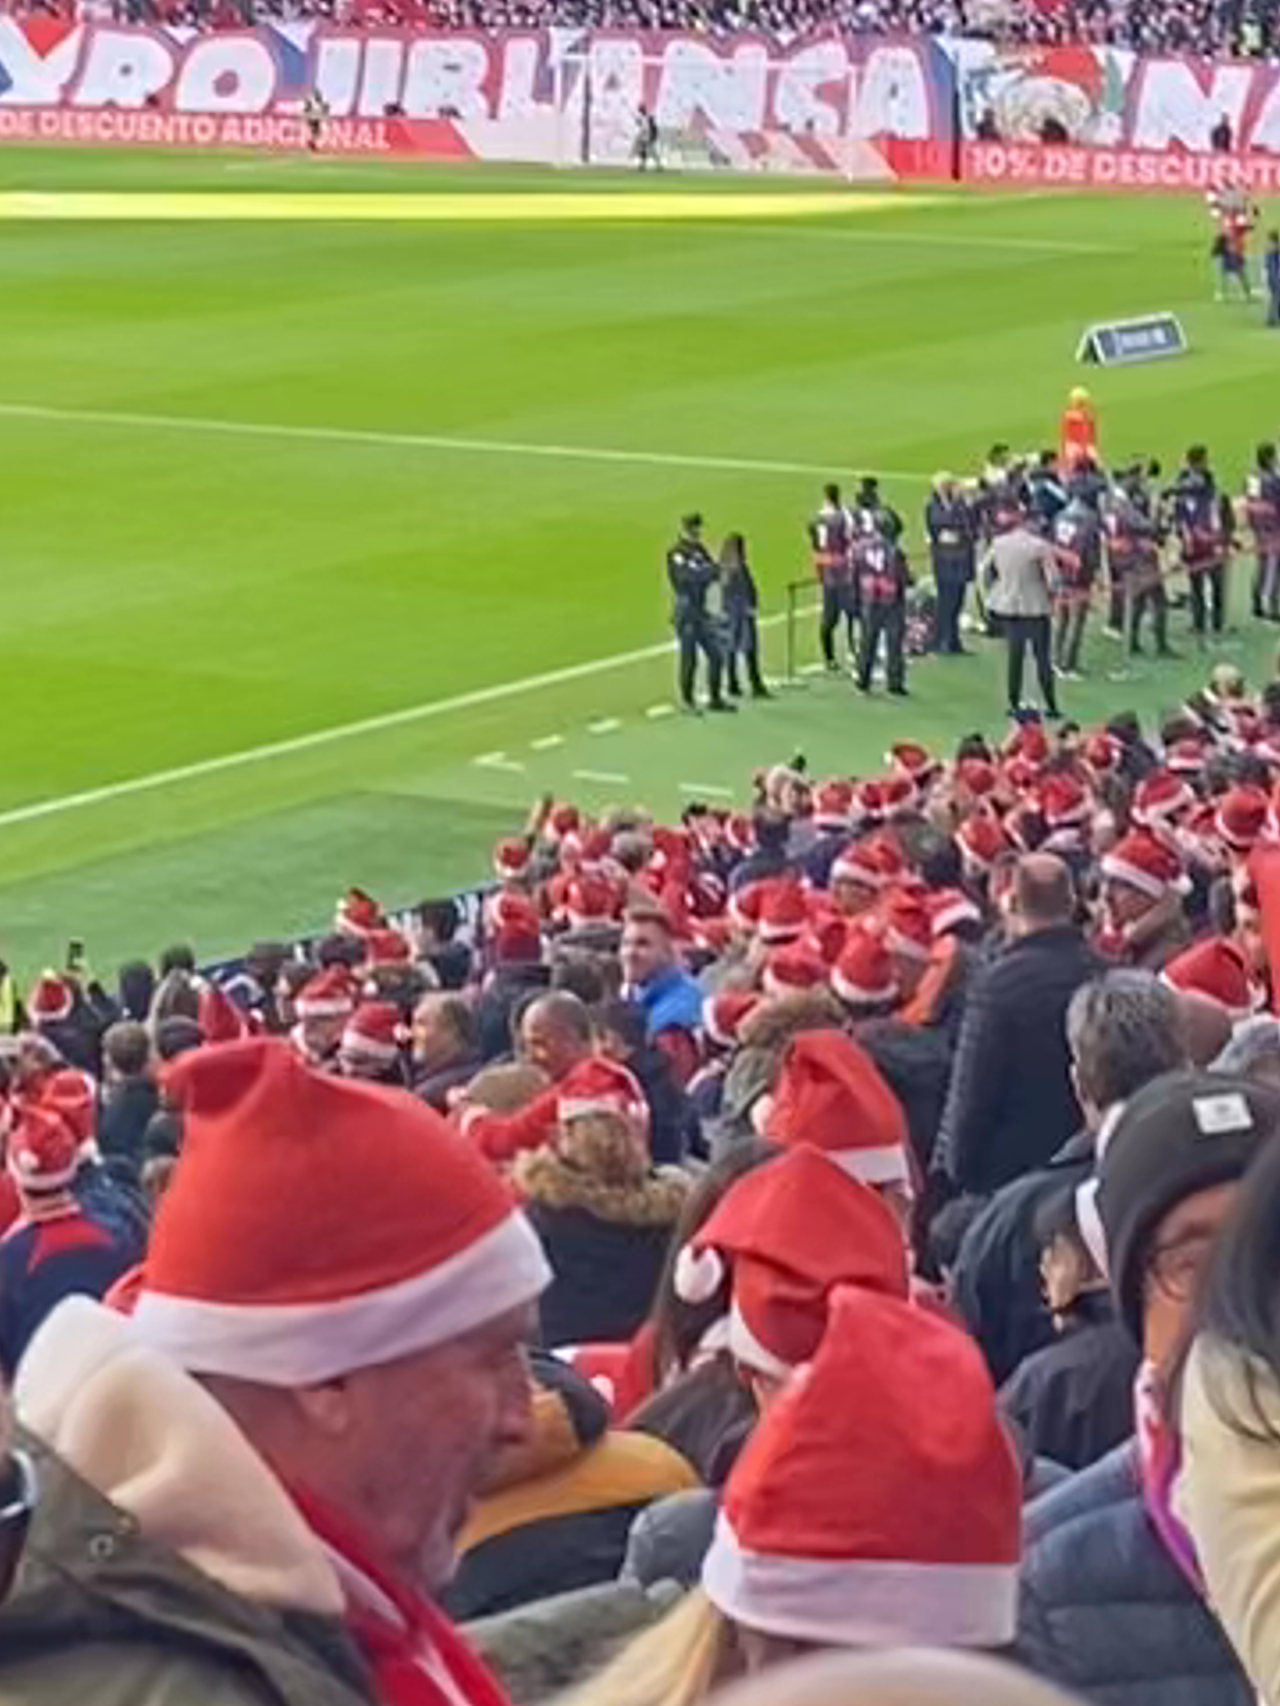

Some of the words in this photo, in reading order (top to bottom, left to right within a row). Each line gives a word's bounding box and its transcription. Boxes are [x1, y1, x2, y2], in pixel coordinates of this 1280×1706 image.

[39, 114, 218, 144] DESCUENTO
[972, 145, 1041, 176] 10%
[1046, 150, 1086, 179] DE
